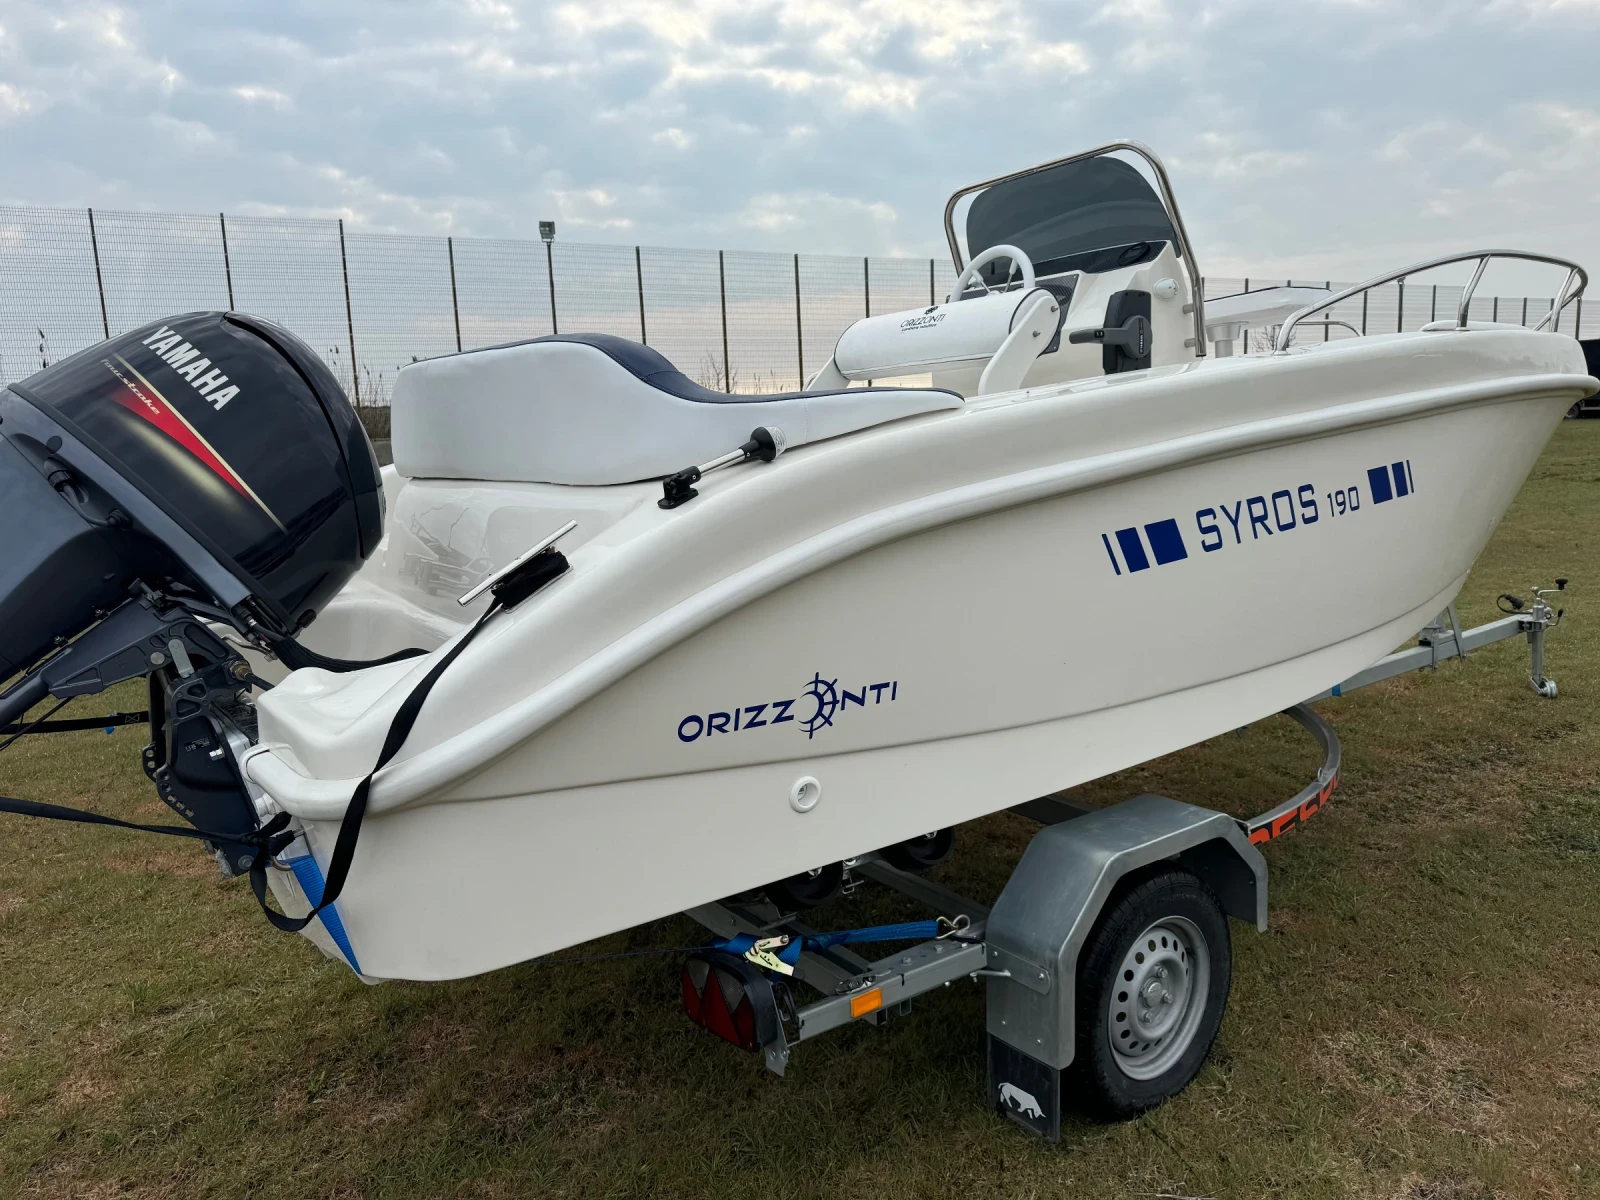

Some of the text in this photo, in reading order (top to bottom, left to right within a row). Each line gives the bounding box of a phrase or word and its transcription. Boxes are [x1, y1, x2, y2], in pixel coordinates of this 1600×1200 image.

[900, 313, 947, 328] ORIZZONTI
[141, 326, 241, 411] YAMAHA
[1195, 483, 1361, 552] SYROS 190
[677, 671, 898, 743] ORIZZONTI
